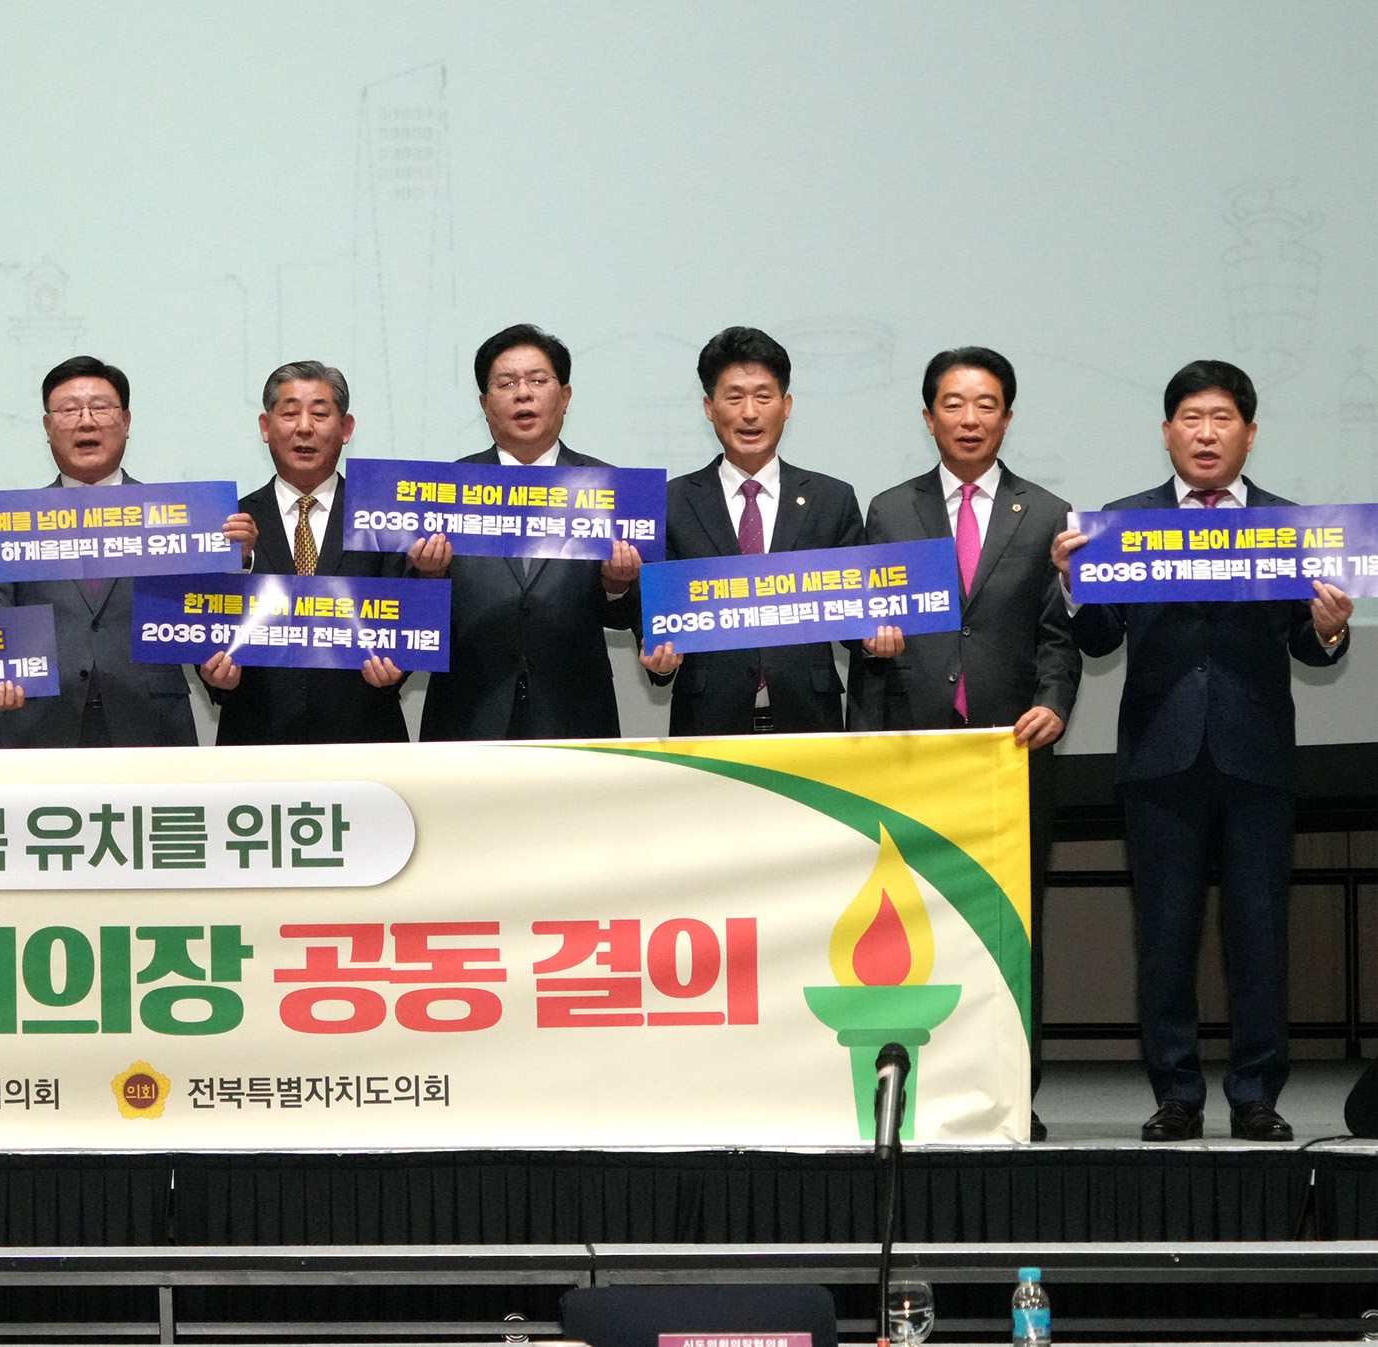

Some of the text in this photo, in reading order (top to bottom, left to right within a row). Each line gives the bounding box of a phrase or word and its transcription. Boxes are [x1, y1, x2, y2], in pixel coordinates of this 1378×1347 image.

[397, 481, 615, 510] 한계를 넘어 새로운 시도
[38, 509, 77, 530] 넘어
[83, 506, 142, 528] 새로운
[148, 505, 187, 526] 시도
[354, 511, 655, 541] 2036 하계올림픽 전북 유치 기원
[1, 538, 98, 562] 하계올림픽
[103, 536, 142, 558] 전북
[148, 533, 186, 556] 유치
[192, 532, 230, 553] 기원
[1122, 528, 1344, 552] 한계를 넘어 새로운 시도
[690, 565, 907, 601] 한계를 넘어 새로운 시도
[1081, 562, 1147, 582] 2036
[1152, 558, 1251, 581] 하계올림픽
[1256, 558, 1297, 579] 전북
[1302, 556, 1342, 578] 유치
[185, 593, 242, 615] 한계를
[294, 597, 354, 619] 새로운
[360, 600, 399, 620] 시도
[653, 590, 949, 635] 2036 하계올림픽 전북 유치 기원
[142, 623, 439, 651] 2036 하계올림픽 전북 유치 기원
[9, 656, 48, 678] 기원
[26, 804, 207, 870] 유치를
[226, 802, 349, 868] 위한
[274, 922, 507, 1034] 공동
[533, 918, 758, 1028] 결의
[126, 1084, 155, 1099] 의회
[188, 1075, 449, 1109] 전북특별자치도의회
